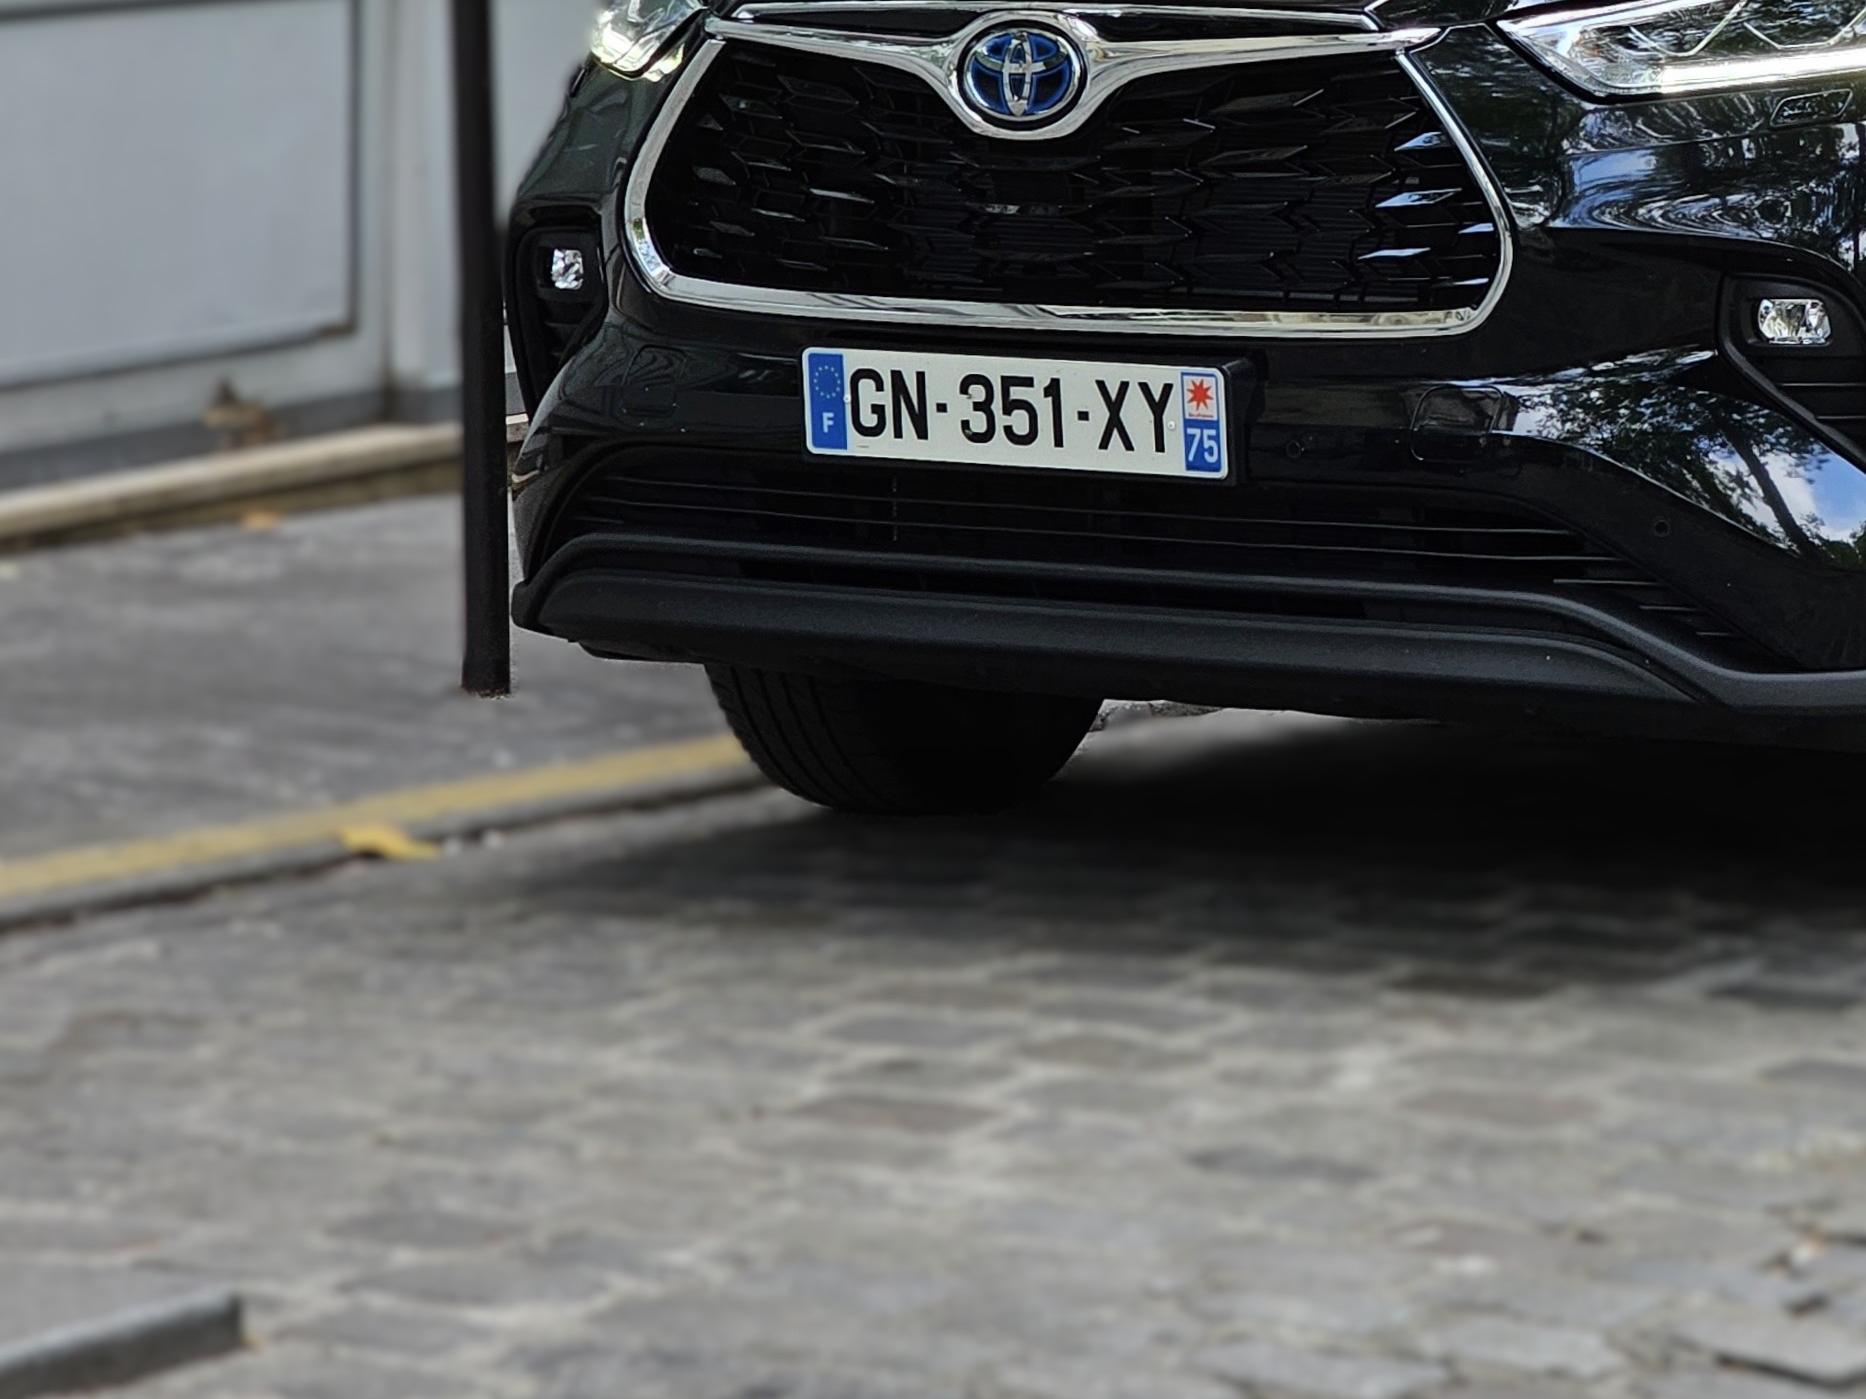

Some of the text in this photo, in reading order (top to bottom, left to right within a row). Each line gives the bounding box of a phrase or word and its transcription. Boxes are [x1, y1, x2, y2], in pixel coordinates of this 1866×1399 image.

[821, 412, 835, 434] F
[849, 367, 1174, 454] GN-351-XY
[1186, 427, 1219, 464] 75
